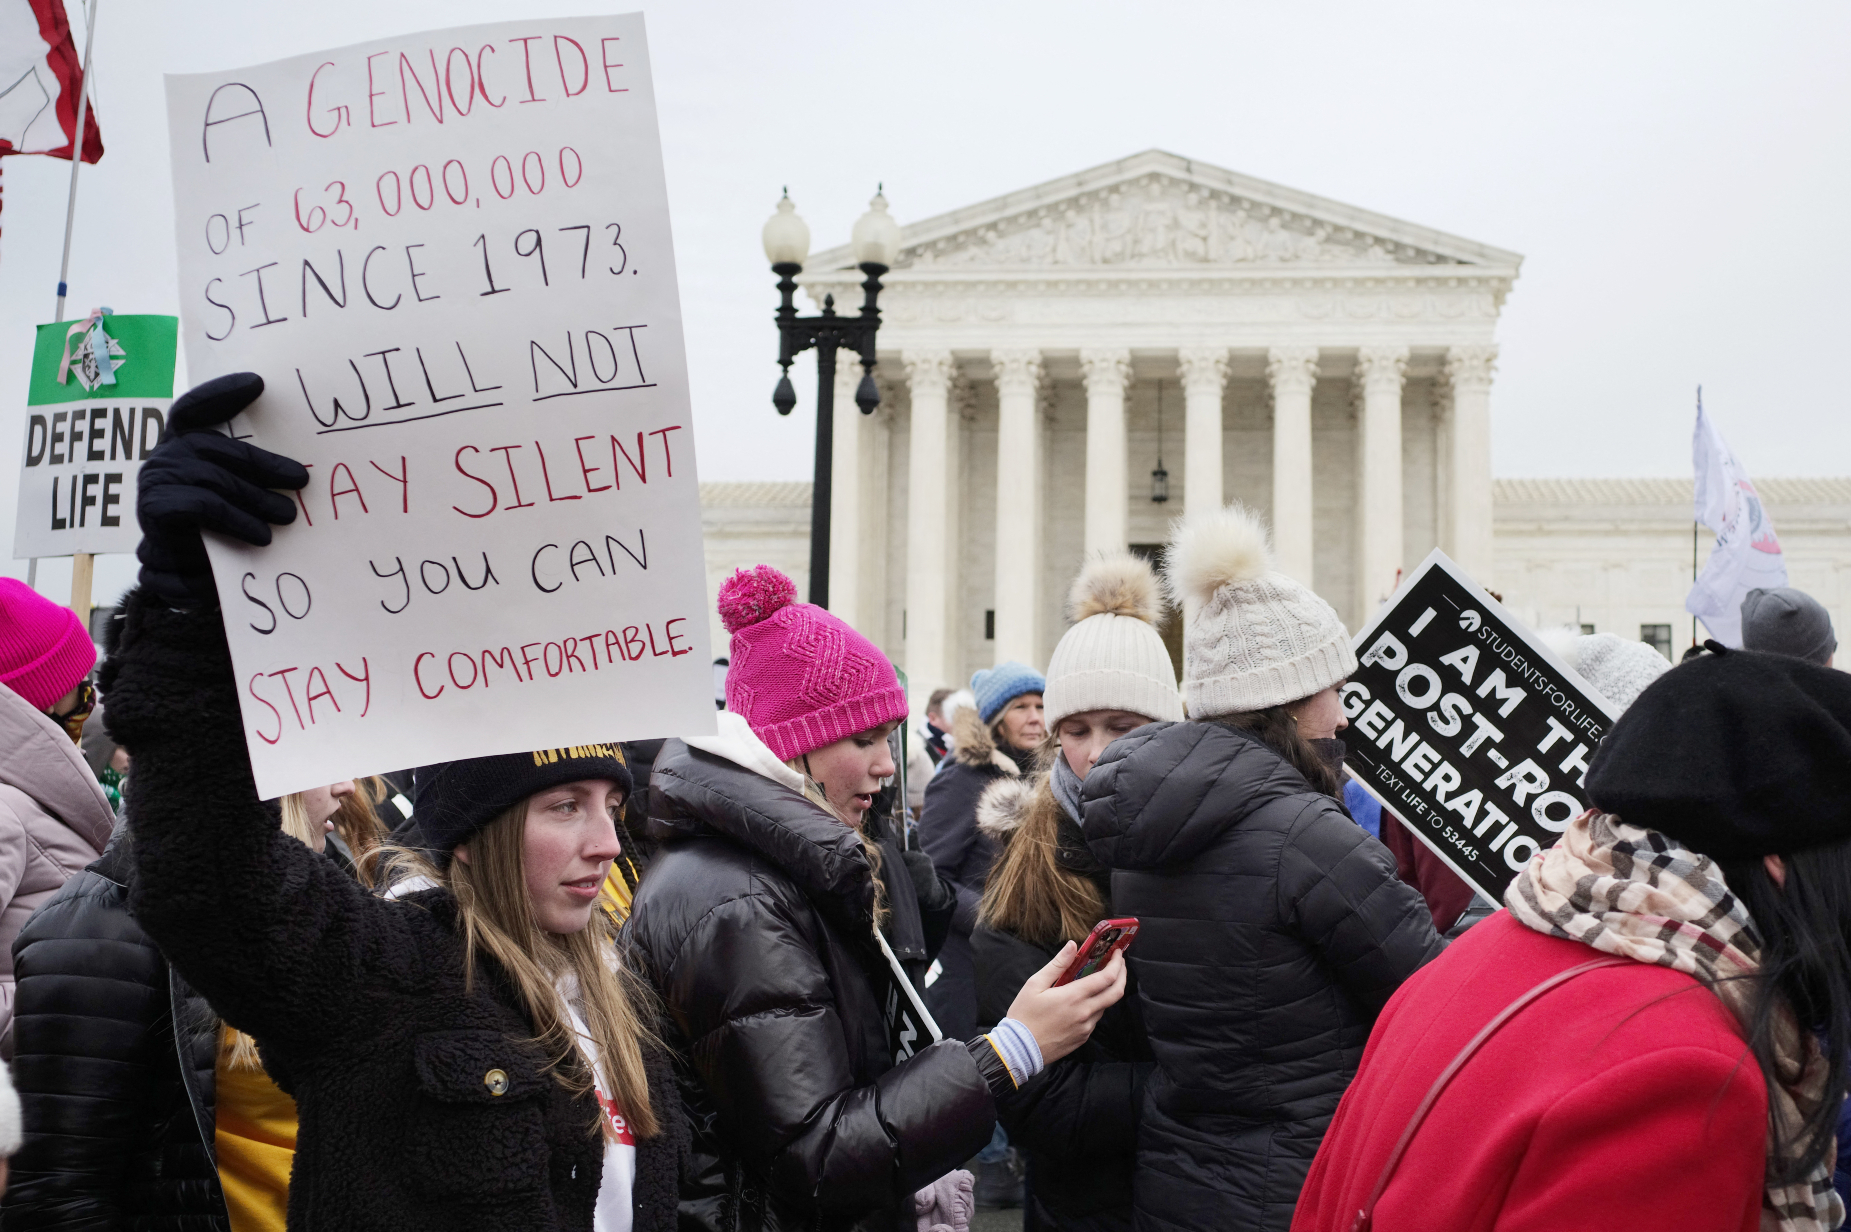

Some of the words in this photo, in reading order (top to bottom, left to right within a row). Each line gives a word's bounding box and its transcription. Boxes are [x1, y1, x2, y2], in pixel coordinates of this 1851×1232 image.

[203, 82, 272, 163] A
[306, 35, 629, 138] GENOCIDE
[205, 203, 260, 255] OF
[294, 146, 582, 233] 63,000,000
[205, 243, 440, 340] SINCE
[473, 223, 638, 296] 1973.
[296, 341, 503, 428] WILL
[530, 325, 648, 394] NOT
[25, 407, 165, 468] DEFEND
[295, 455, 408, 526] TAY
[453, 426, 682, 518] SILENT
[51, 473, 123, 530] LIFE
[242, 572, 311, 634] SO
[531, 529, 647, 593] CAN
[248, 657, 370, 744] STAY
[413, 617, 693, 699] COMFORTABLE.
[1360, 630, 1584, 832] POST-RO
[1408, 606, 1438, 638] I
[1439, 644, 1528, 719] AM
[1536, 715, 1589, 790] TH
[1338, 681, 1541, 873] GENERATIO
[1376, 764, 1405, 791] TEXT
[1401, 789, 1428, 815] LIFE
[1426, 810, 1443, 828] TO
[1442, 826, 1480, 861] 53445
